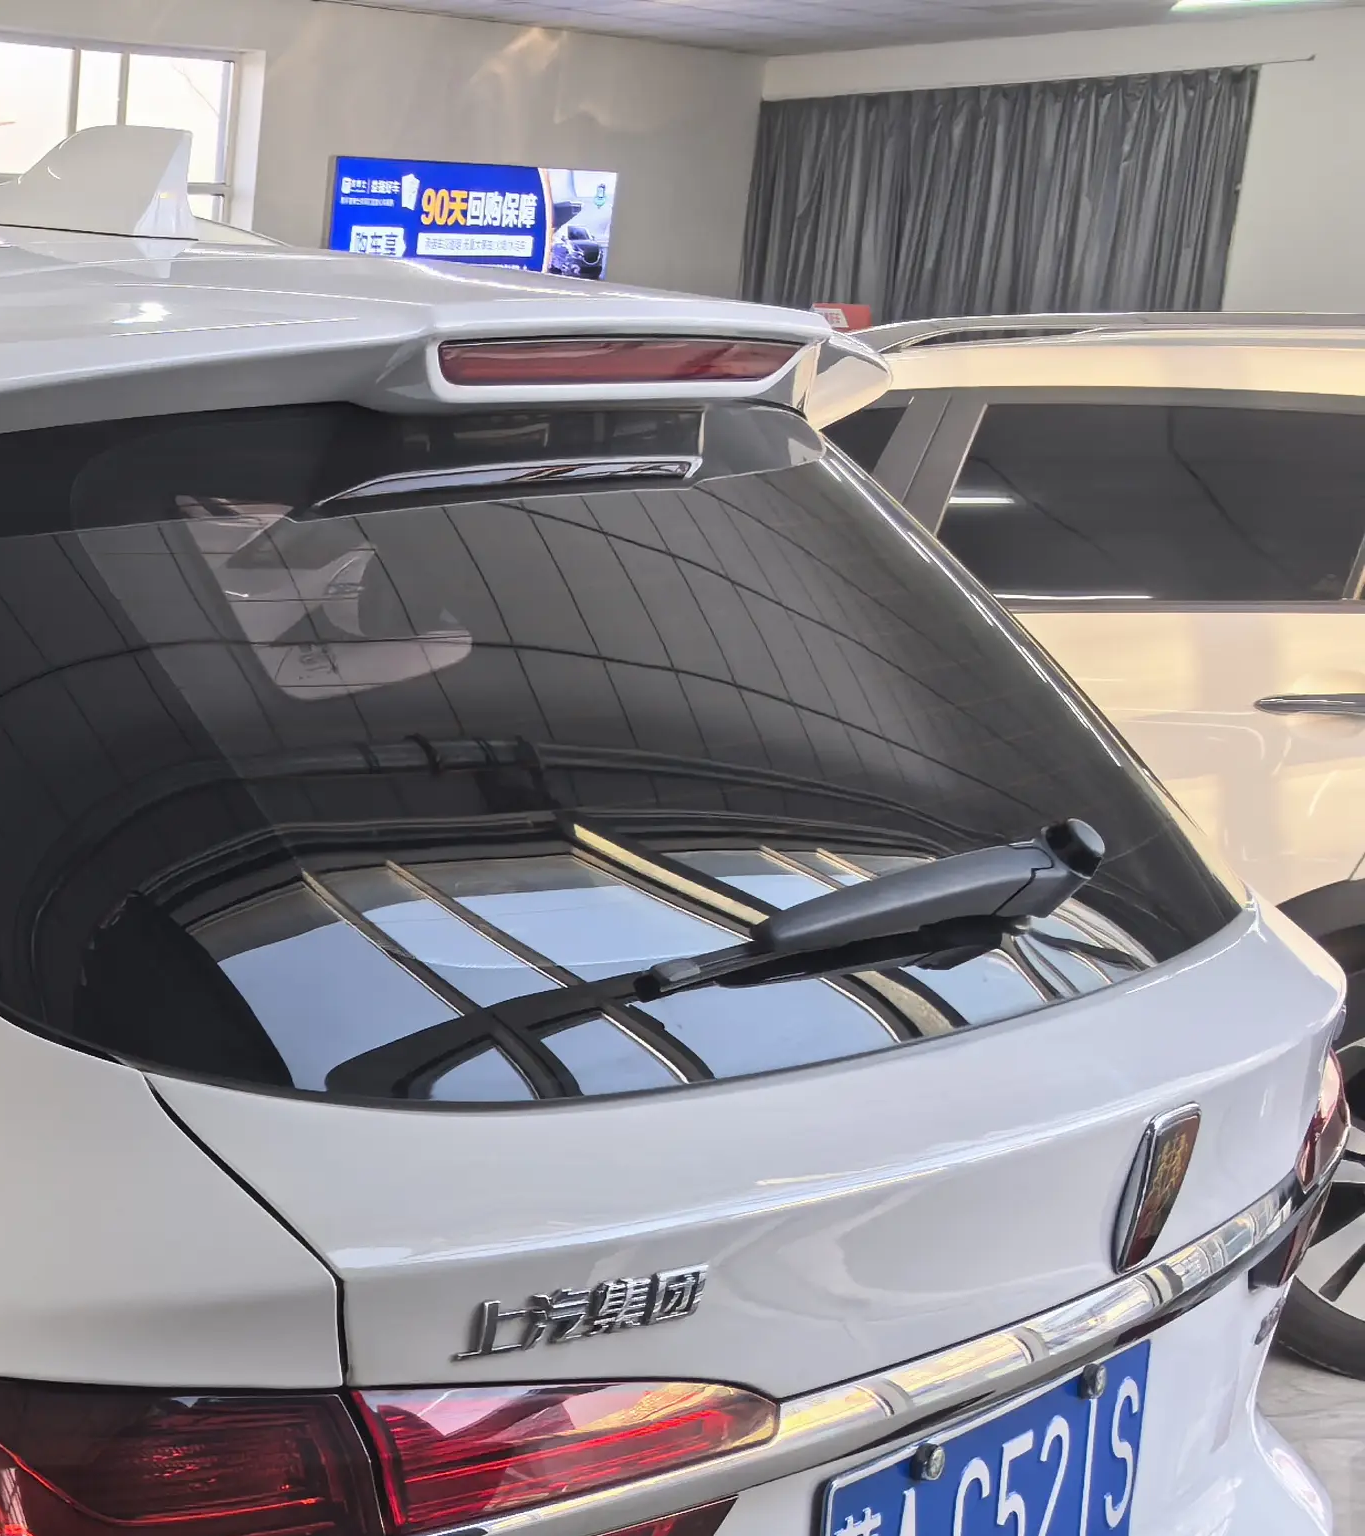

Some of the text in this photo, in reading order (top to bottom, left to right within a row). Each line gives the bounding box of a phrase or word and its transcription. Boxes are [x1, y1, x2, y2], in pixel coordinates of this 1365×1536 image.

[420, 187, 538, 229] 90天回购保障
[452, 1262, 709, 1362] 上汽集团
